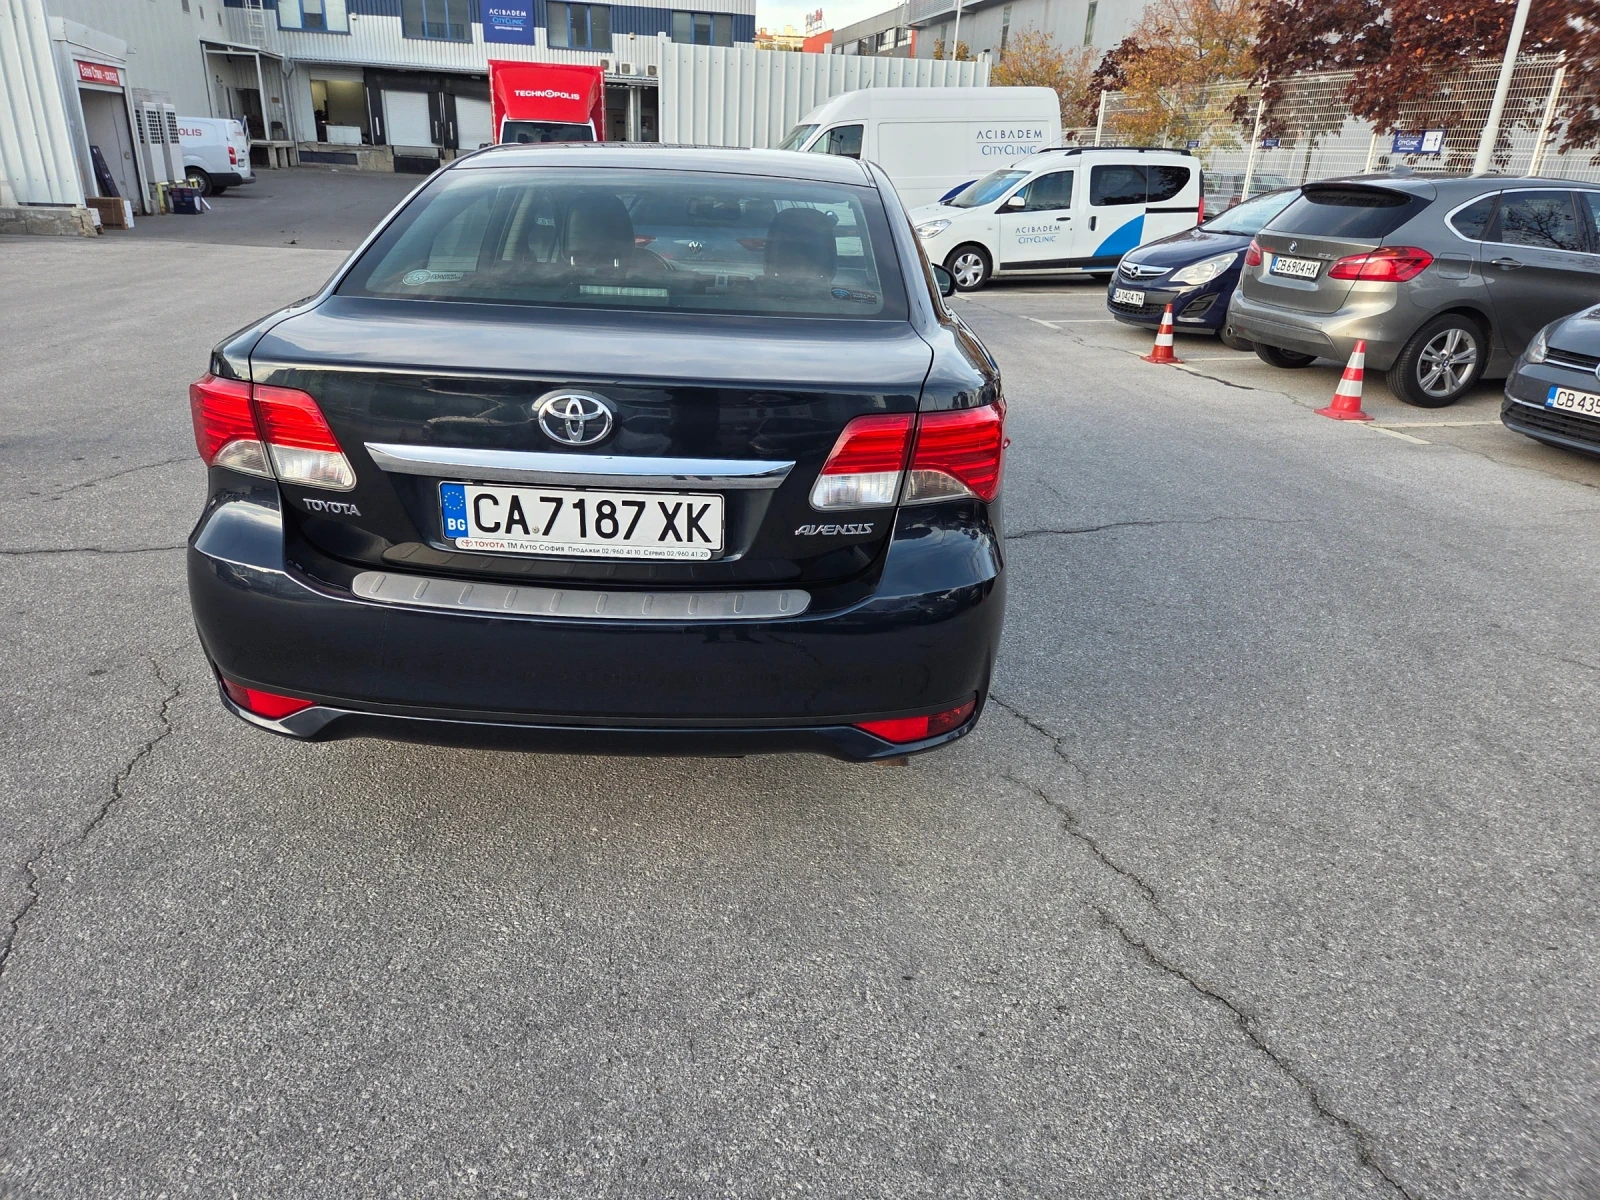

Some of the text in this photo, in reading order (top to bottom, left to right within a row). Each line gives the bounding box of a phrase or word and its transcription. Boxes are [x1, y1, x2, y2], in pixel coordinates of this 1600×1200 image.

[489, 8, 527, 17] ACIBADEM
[514, 89, 580, 100] TECHNOPOLIS
[976, 129, 1043, 139] ACIBADEM
[1015, 225, 1061, 234] ACIBADEM
[1276, 259, 1286, 271] CB
[1286, 260, 1306, 274] 6904
[1556, 391, 1575, 408] CB
[302, 497, 362, 517] TOYOTA
[447, 517, 466, 531] BG
[473, 493, 713, 543] CA 7187 XK
[794, 522, 875, 536] AVENSIS
[474, 540, 505, 549] TOYOTA
